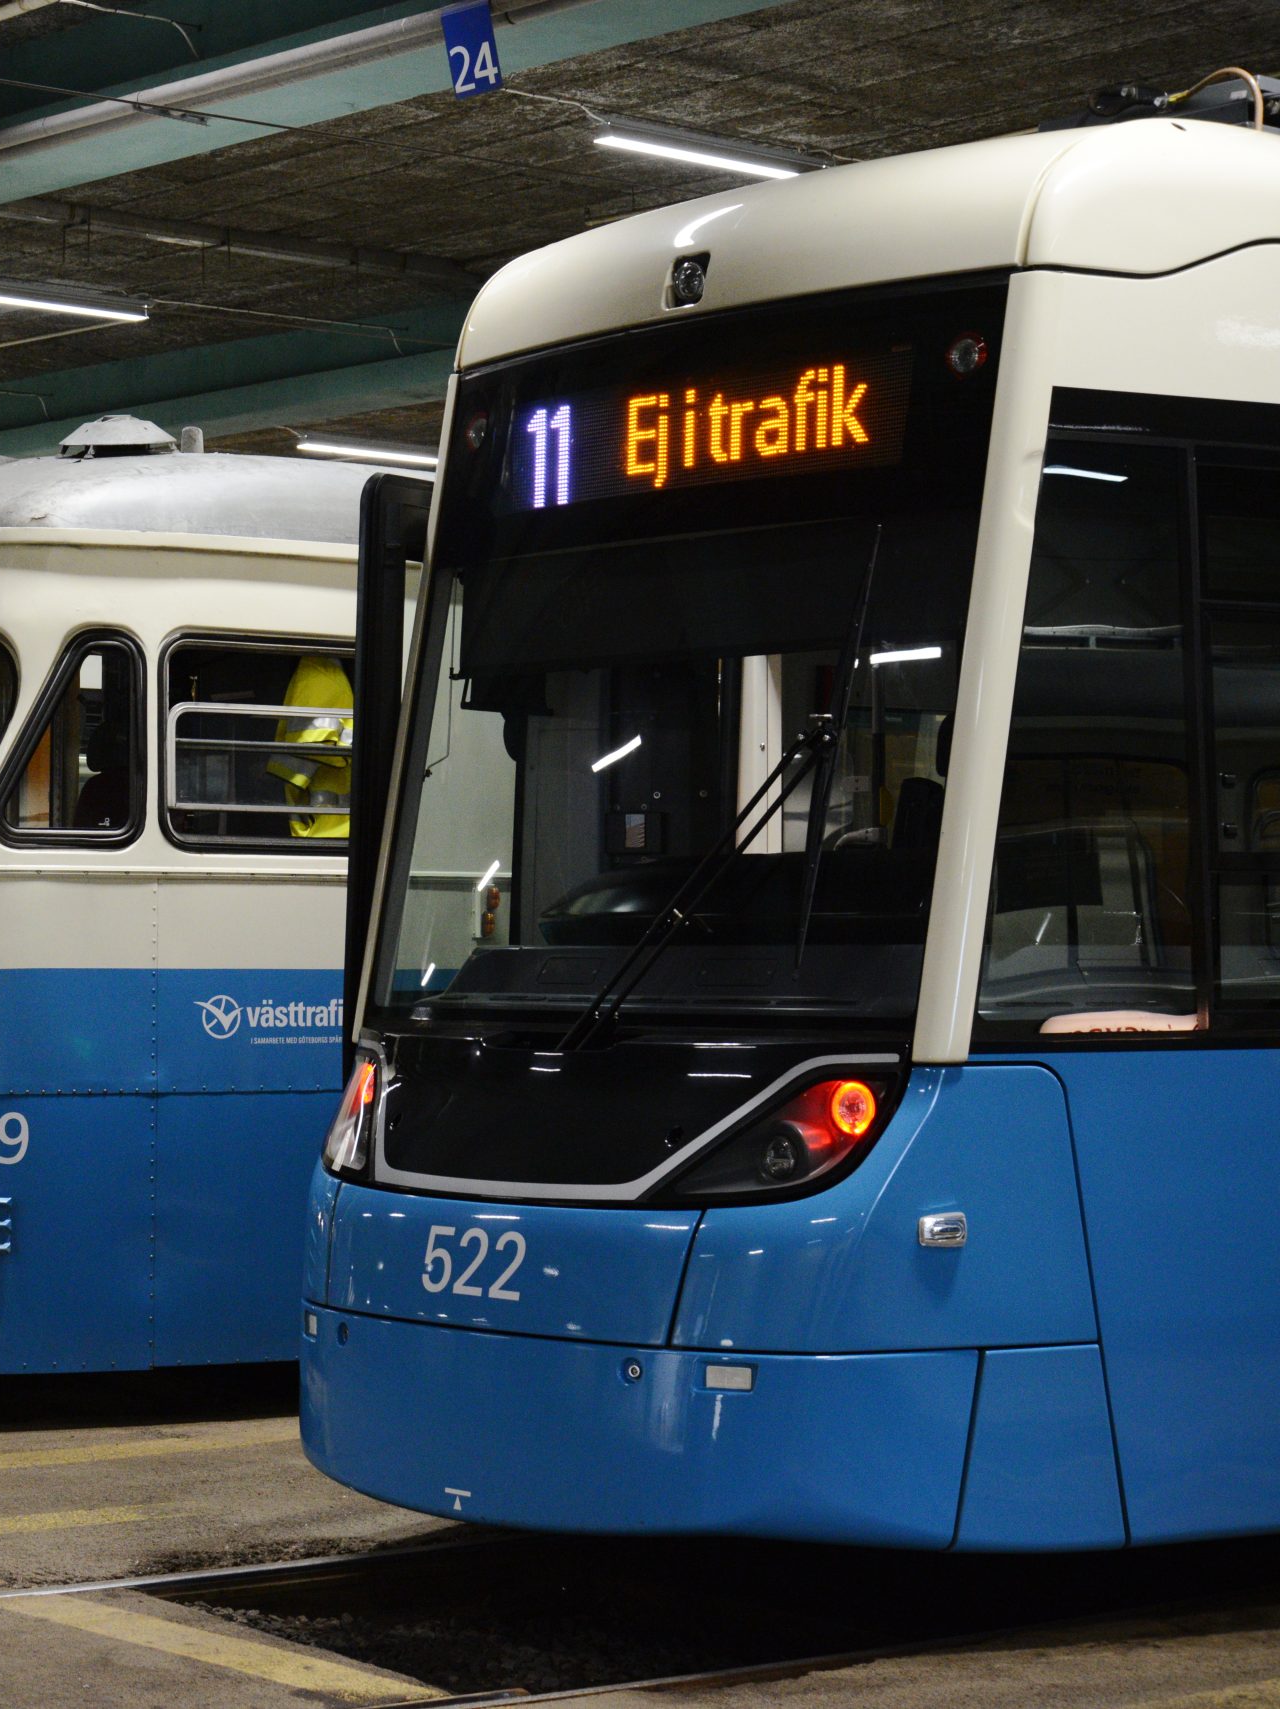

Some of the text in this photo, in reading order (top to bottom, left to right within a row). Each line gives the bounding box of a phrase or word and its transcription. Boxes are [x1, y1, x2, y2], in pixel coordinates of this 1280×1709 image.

[449, 41, 498, 93] 24
[527, 364, 869, 509] 11 Ej i trafik
[246, 999, 344, 1028] västtrafi
[286, 1036, 298, 1044] MED
[422, 1225, 527, 1301] 522
